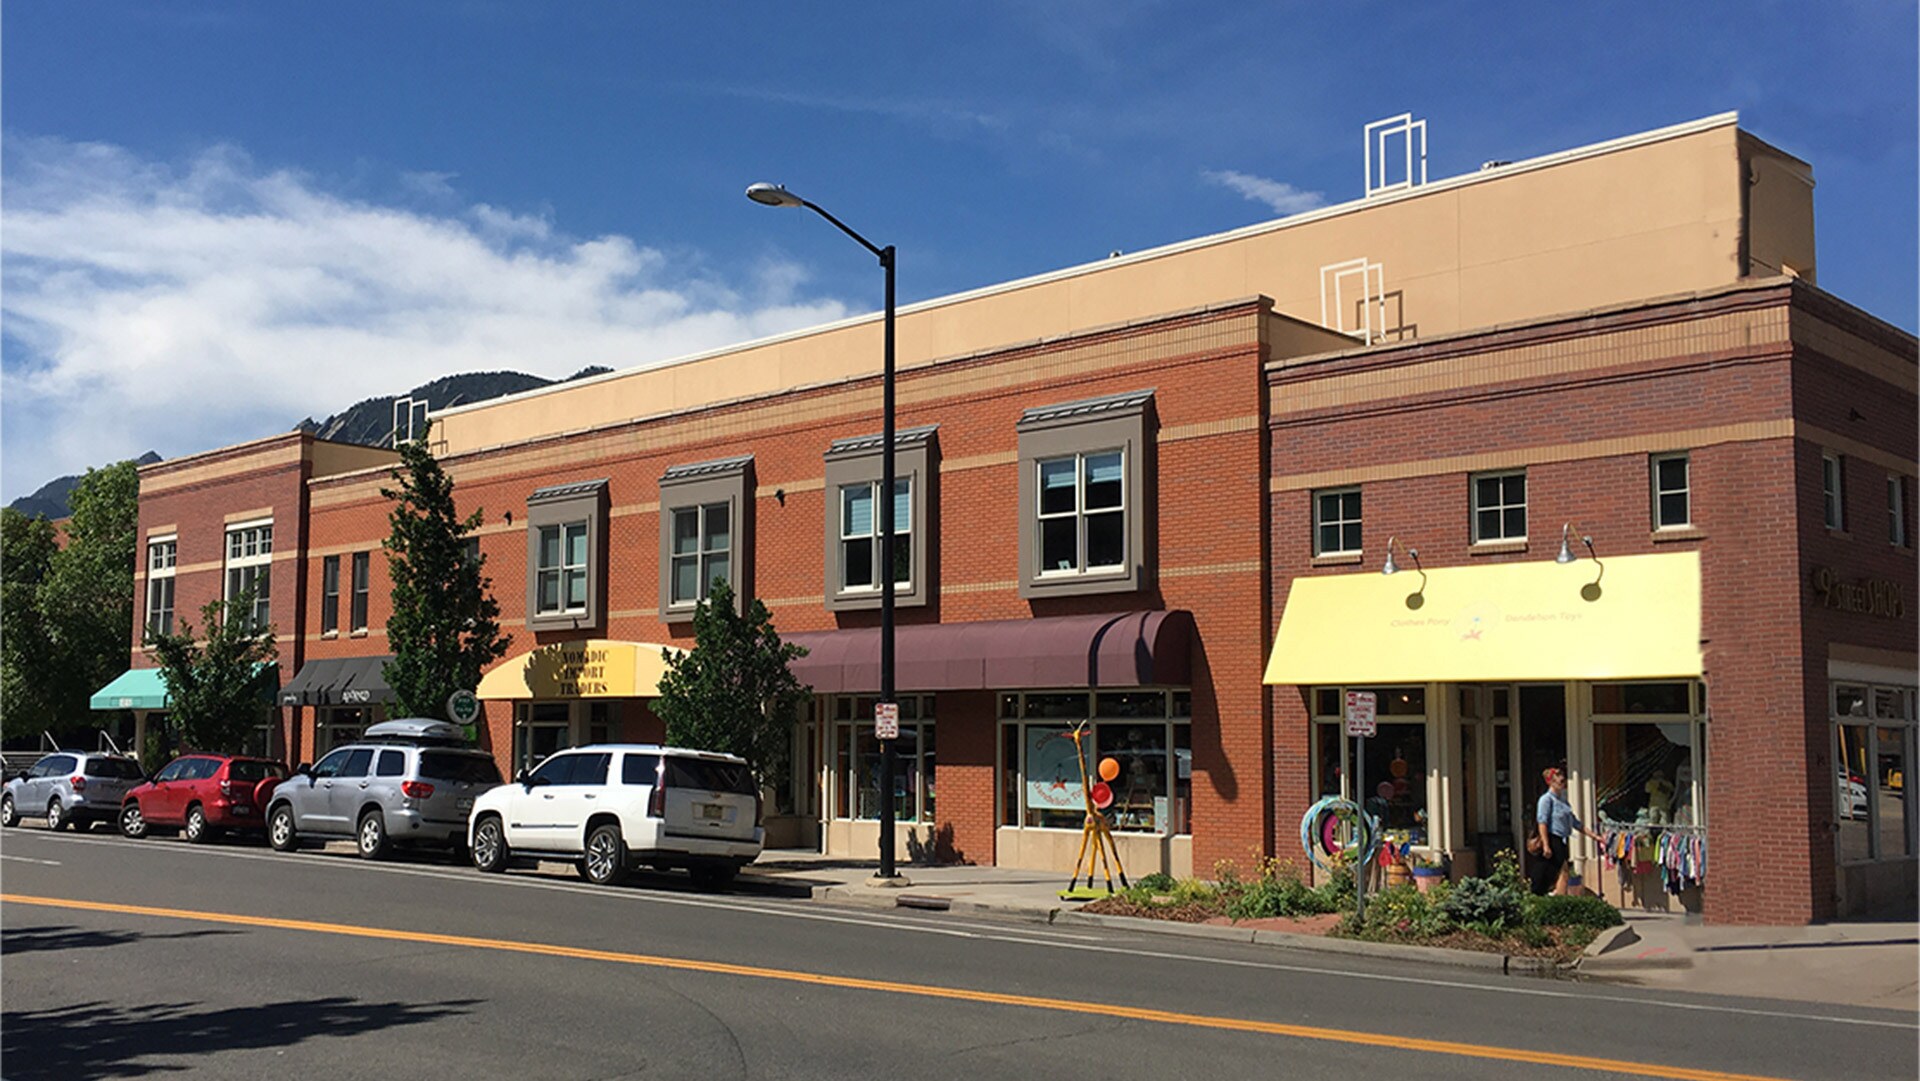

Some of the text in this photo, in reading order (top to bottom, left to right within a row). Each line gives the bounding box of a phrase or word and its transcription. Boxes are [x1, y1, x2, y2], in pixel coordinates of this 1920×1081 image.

[1867, 579, 1906, 619] SHOPS
[562, 650, 610, 664] NOMADIC
[564, 665, 605, 679] IMPORT
[560, 681, 609, 695] TRADERS
